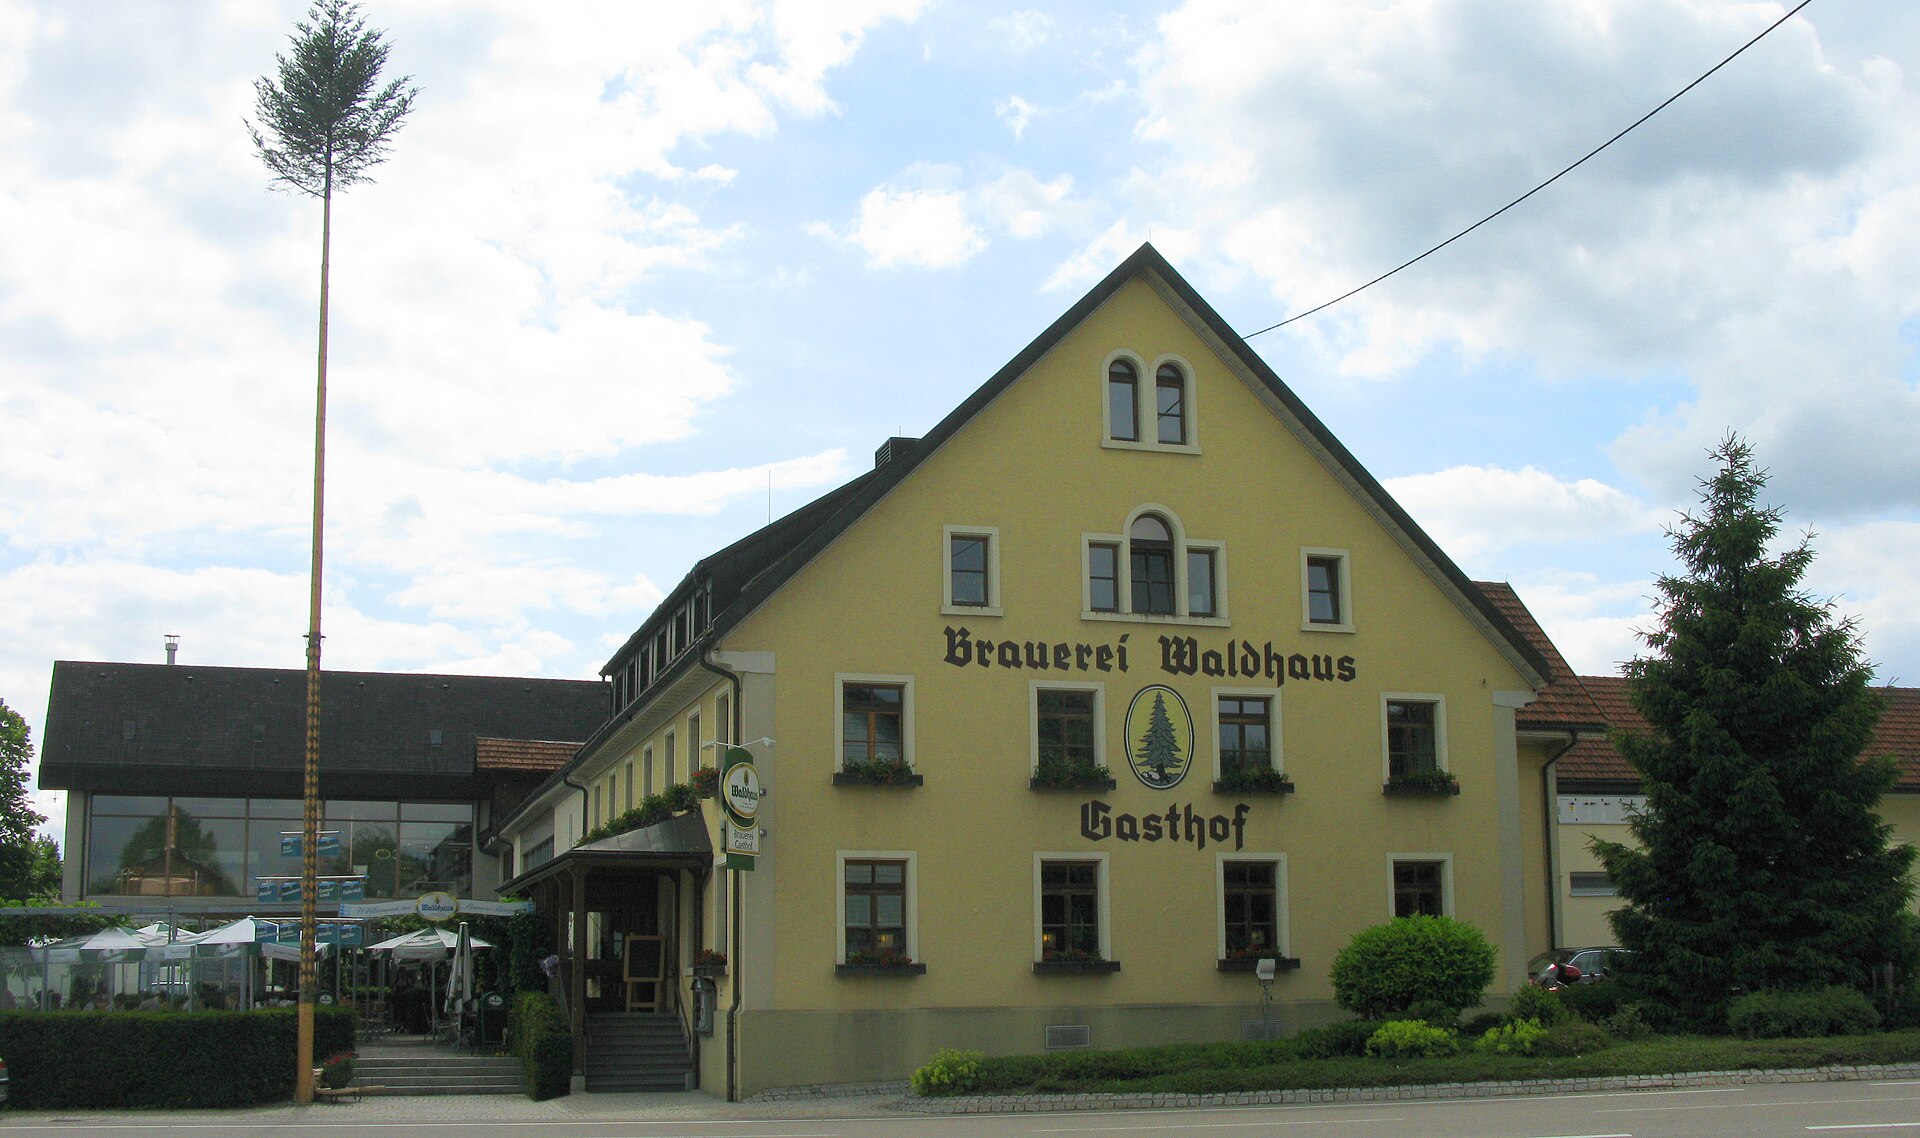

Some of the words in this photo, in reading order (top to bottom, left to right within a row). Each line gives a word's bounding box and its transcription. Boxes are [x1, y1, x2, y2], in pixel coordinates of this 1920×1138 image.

[943, 625, 1130, 673] Brauerei
[1158, 634, 1356, 687] Waldhaus
[731, 784, 758, 802] Waldhaus
[1080, 800, 1251, 852] Gasthof
[733, 830, 754, 840] Brauerei
[734, 840, 753, 851] Gasthof
[421, 904, 454, 912] Waldhaus
